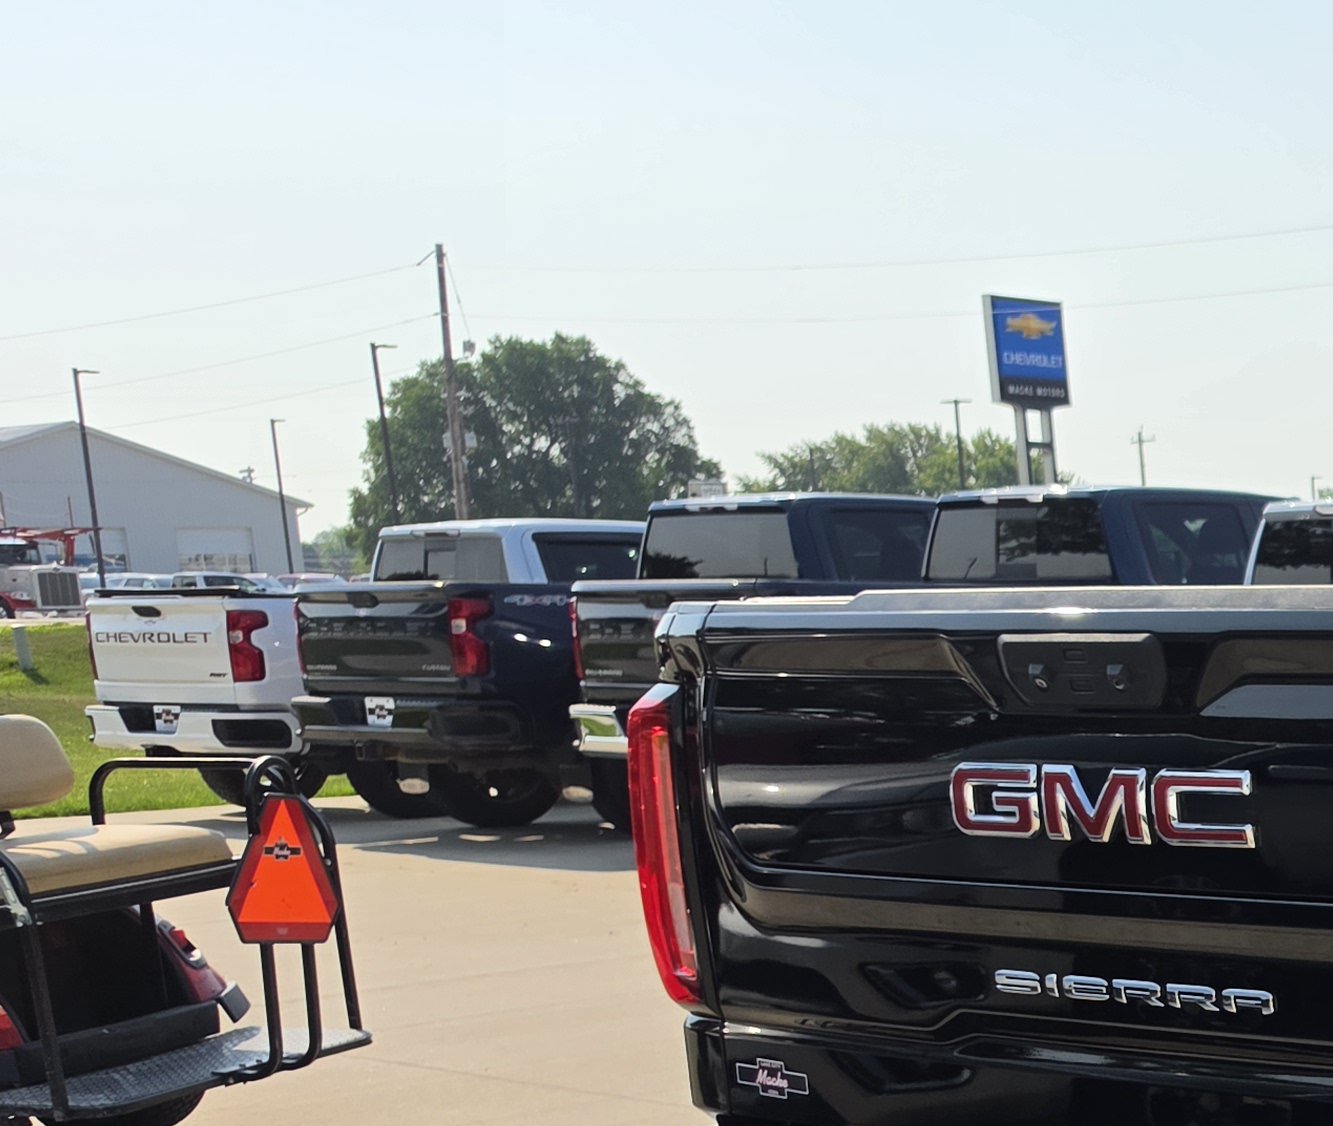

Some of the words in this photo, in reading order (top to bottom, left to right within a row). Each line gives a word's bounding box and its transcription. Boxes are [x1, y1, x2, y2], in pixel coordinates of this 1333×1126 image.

[1003, 351, 1062, 368] CHEVROLET
[95, 632, 212, 644] CHEVROLET
[950, 762, 1255, 848] GMC
[994, 969, 1275, 1015] SIERRA
